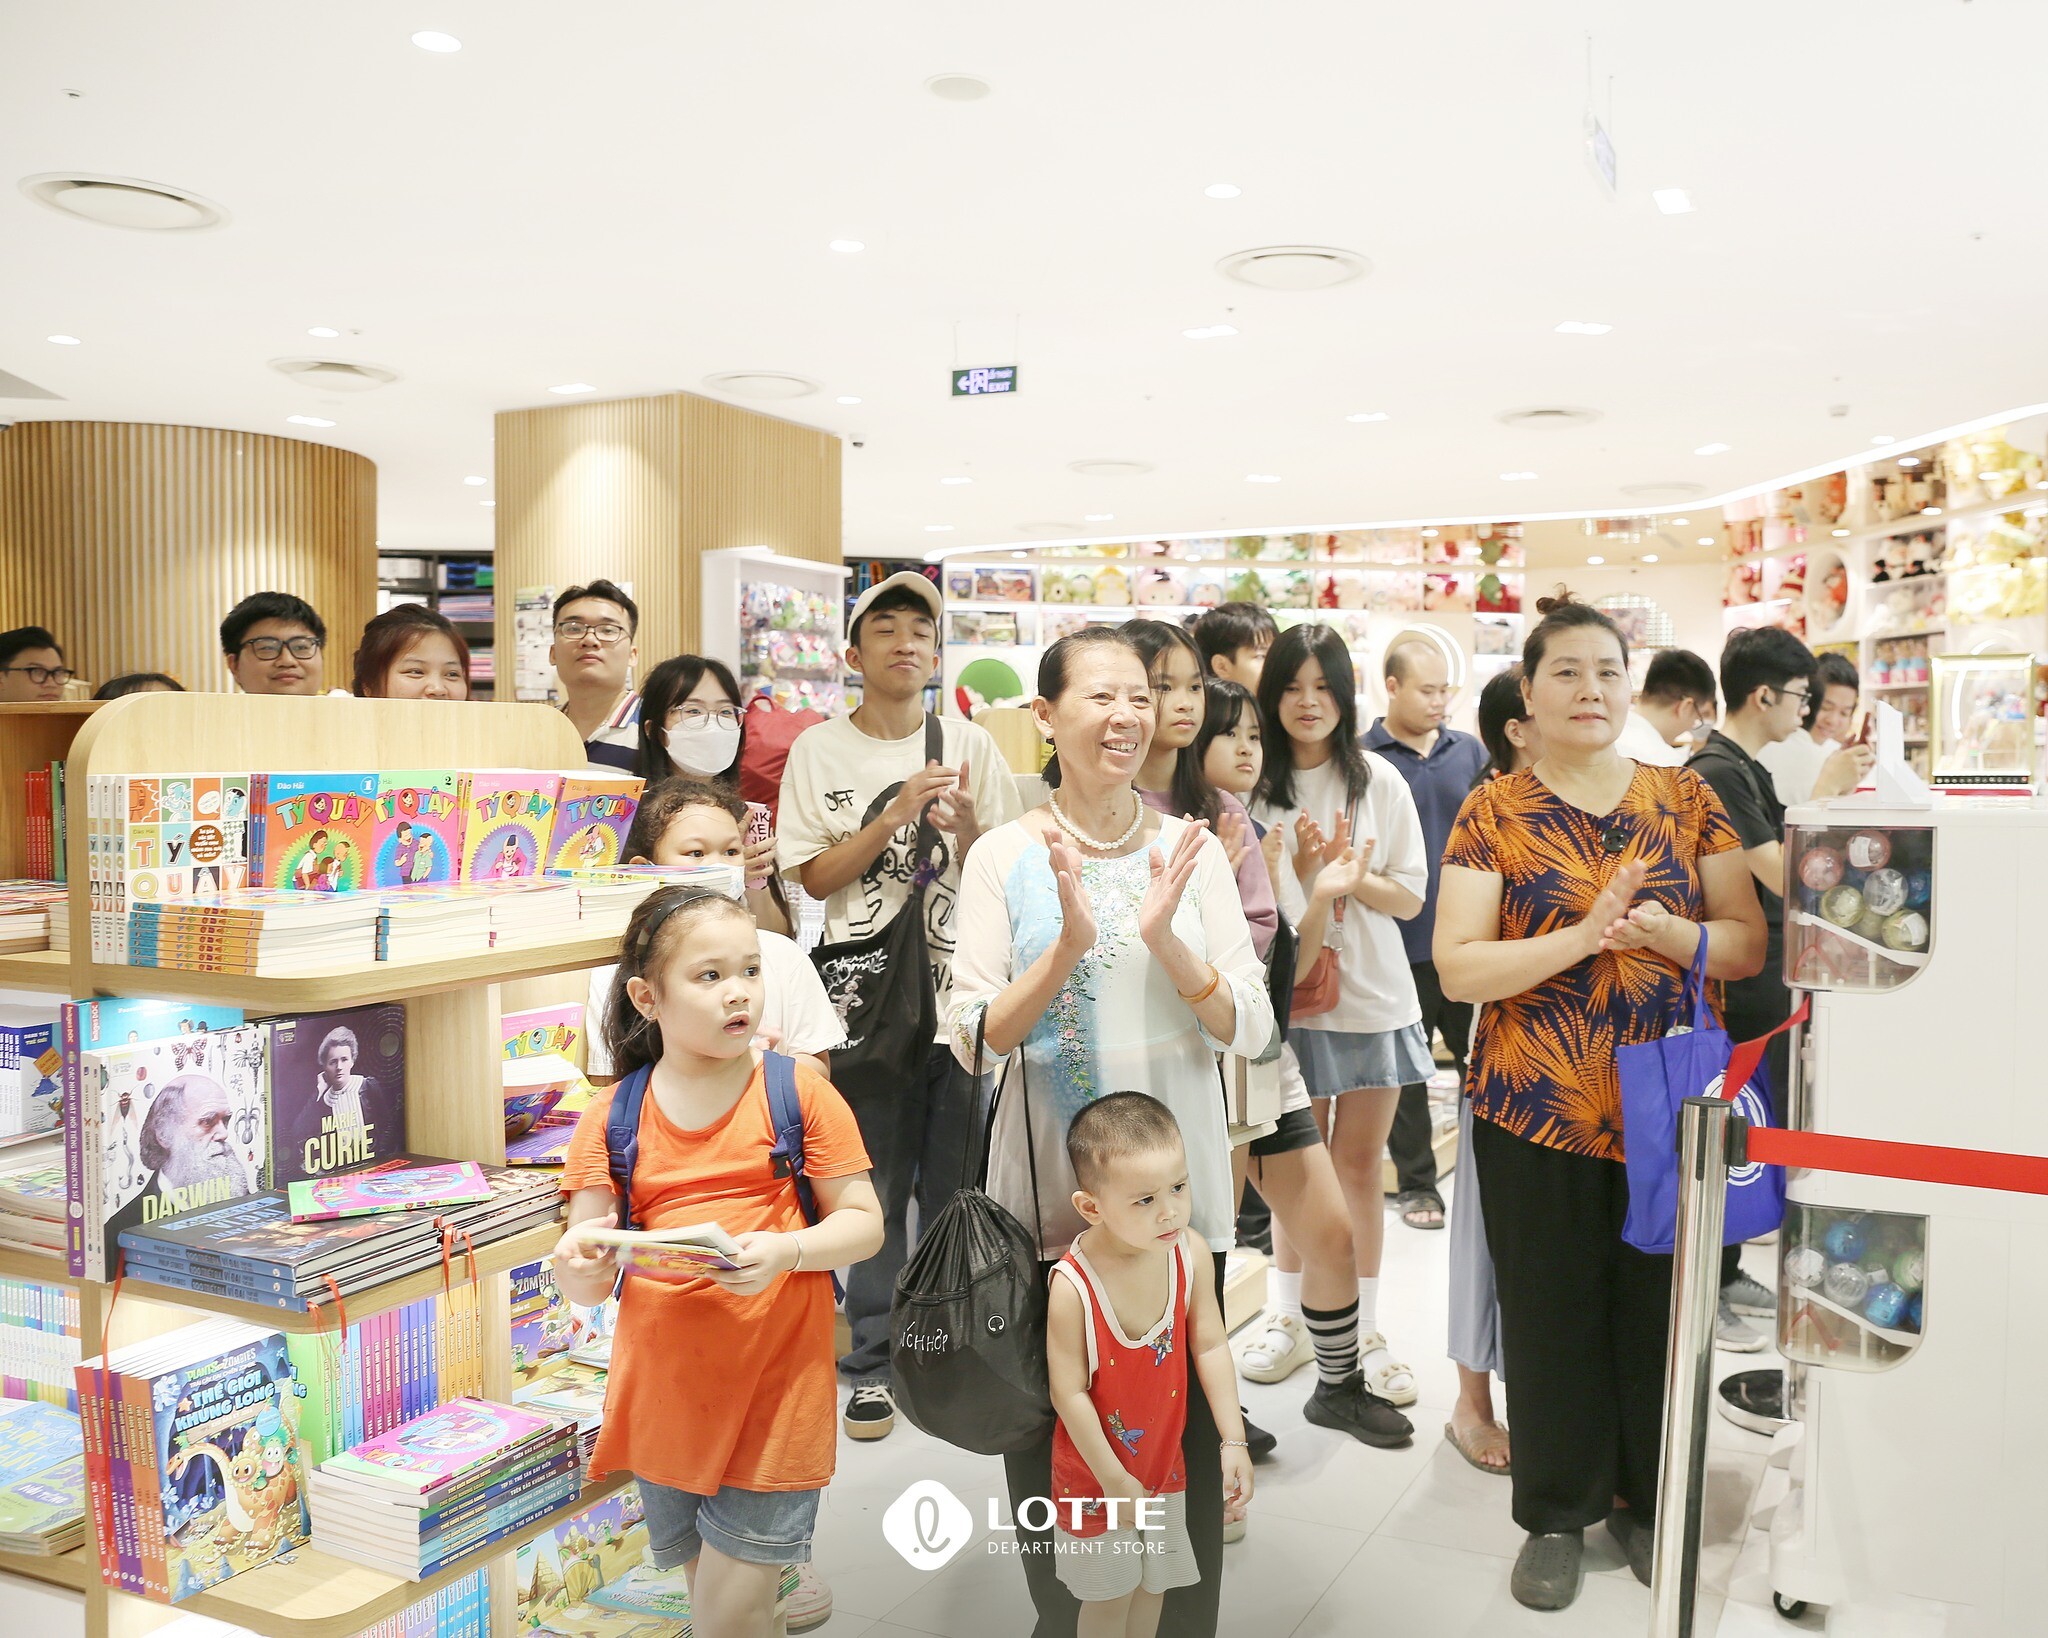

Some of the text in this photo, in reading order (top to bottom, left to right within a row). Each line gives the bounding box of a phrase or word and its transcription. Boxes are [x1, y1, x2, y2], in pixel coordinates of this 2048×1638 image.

[445, 776, 452, 786] 2
[545, 780, 554, 789] 3
[276, 791, 374, 830] TÝ QUẬY
[374, 786, 456, 824] TÝ QUẬY
[476, 788, 553, 823] TÝ QUẬY
[567, 794, 636, 823] TÝ QUẬY
[505, 1023, 576, 1058] TÝ QUẬY
[321, 1110, 357, 1133] MARIE
[304, 1124, 376, 1175] CURIE
[142, 1176, 231, 1224] DARWIN
[186, 1347, 257, 1381] PLANTS ZOMBIES
[190, 1379, 226, 1409] THẾ
[227, 1369, 262, 1396] GIỚI
[174, 1399, 234, 1432] KHỦNG
[234, 1382, 275, 1411] LONG
